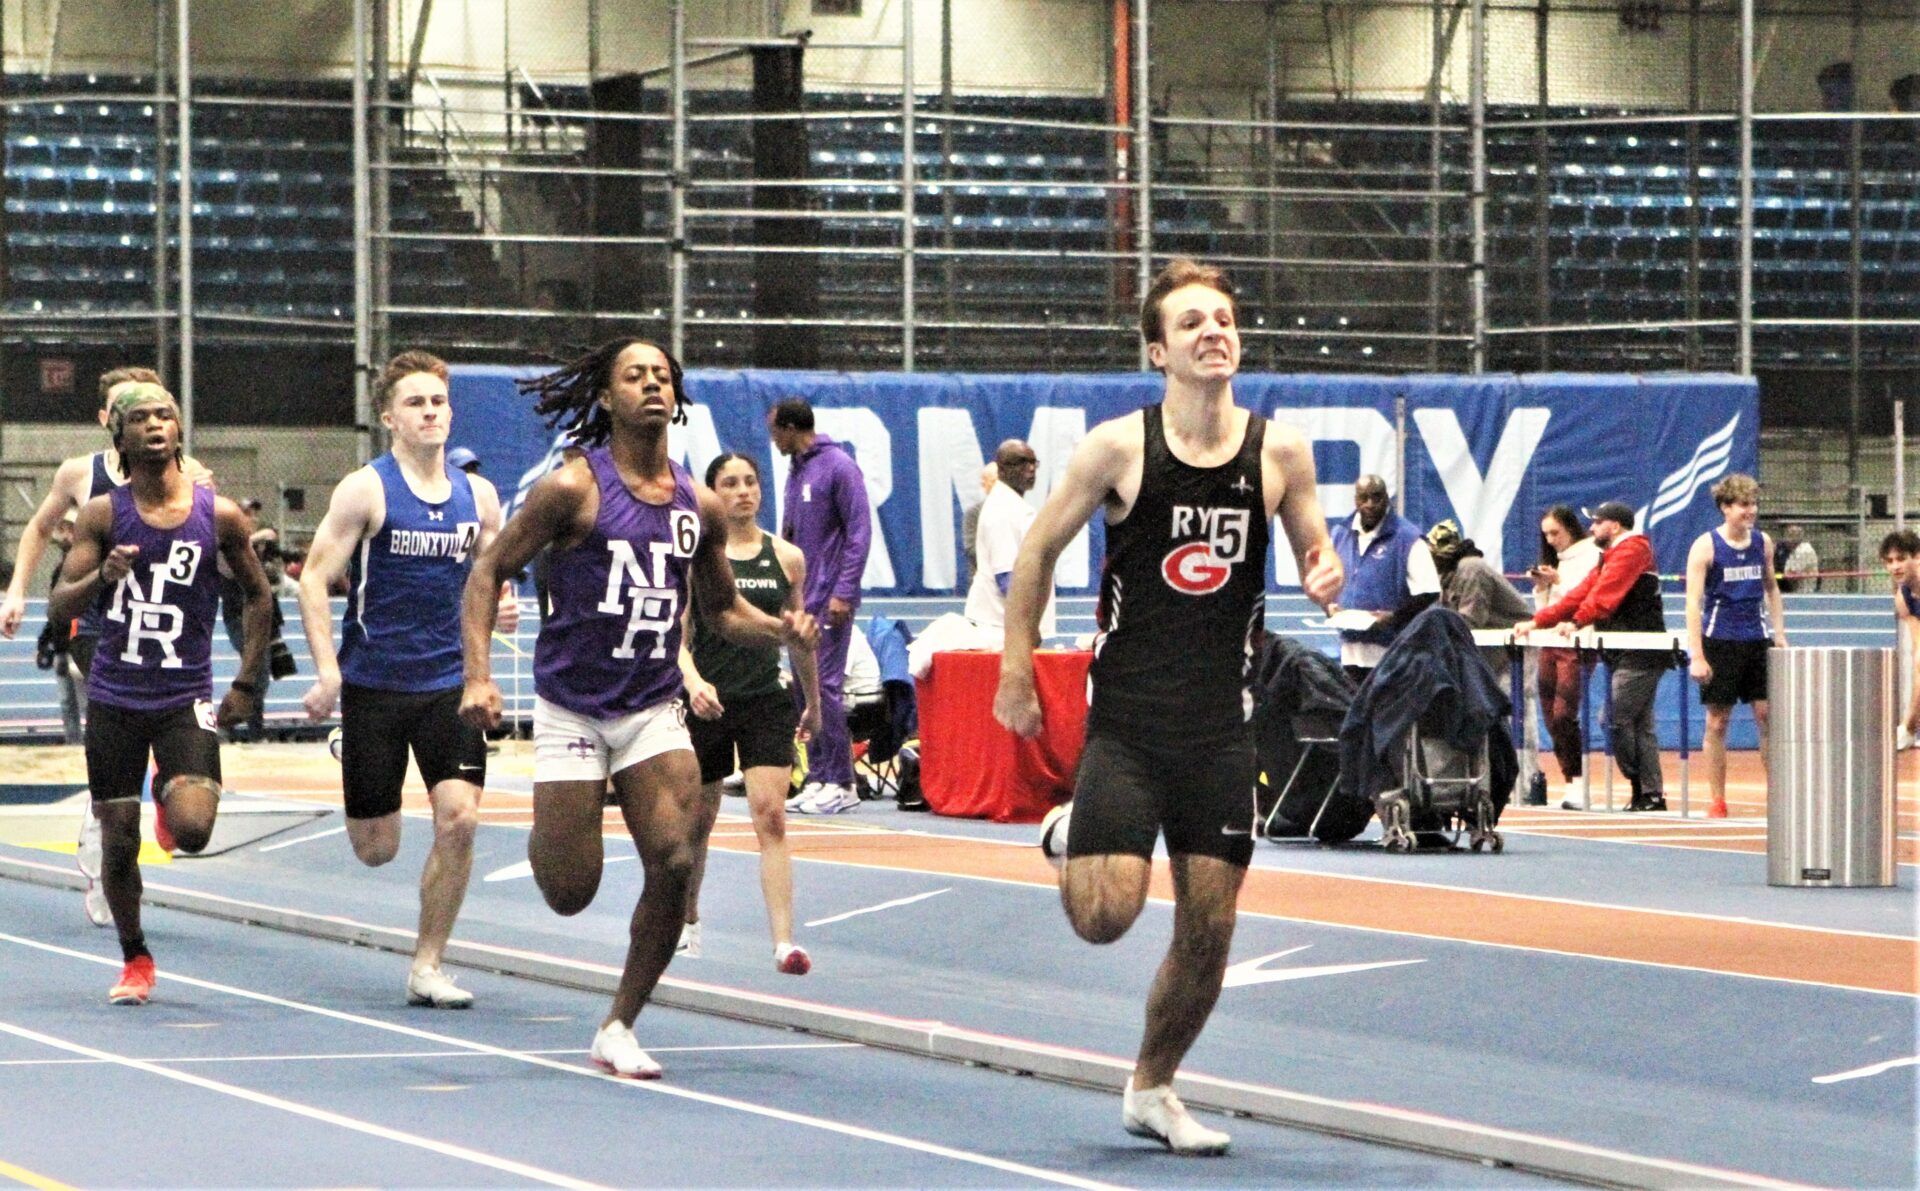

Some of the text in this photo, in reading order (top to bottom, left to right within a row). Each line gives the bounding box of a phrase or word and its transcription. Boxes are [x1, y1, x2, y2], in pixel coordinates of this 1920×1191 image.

[657, 404, 1551, 588] RMRY
[461, 526, 475, 555] 4
[676, 514, 696, 554] 6
[1215, 513, 1241, 560] 5
[170, 546, 195, 581] 3
[1161, 541, 1231, 595] G
